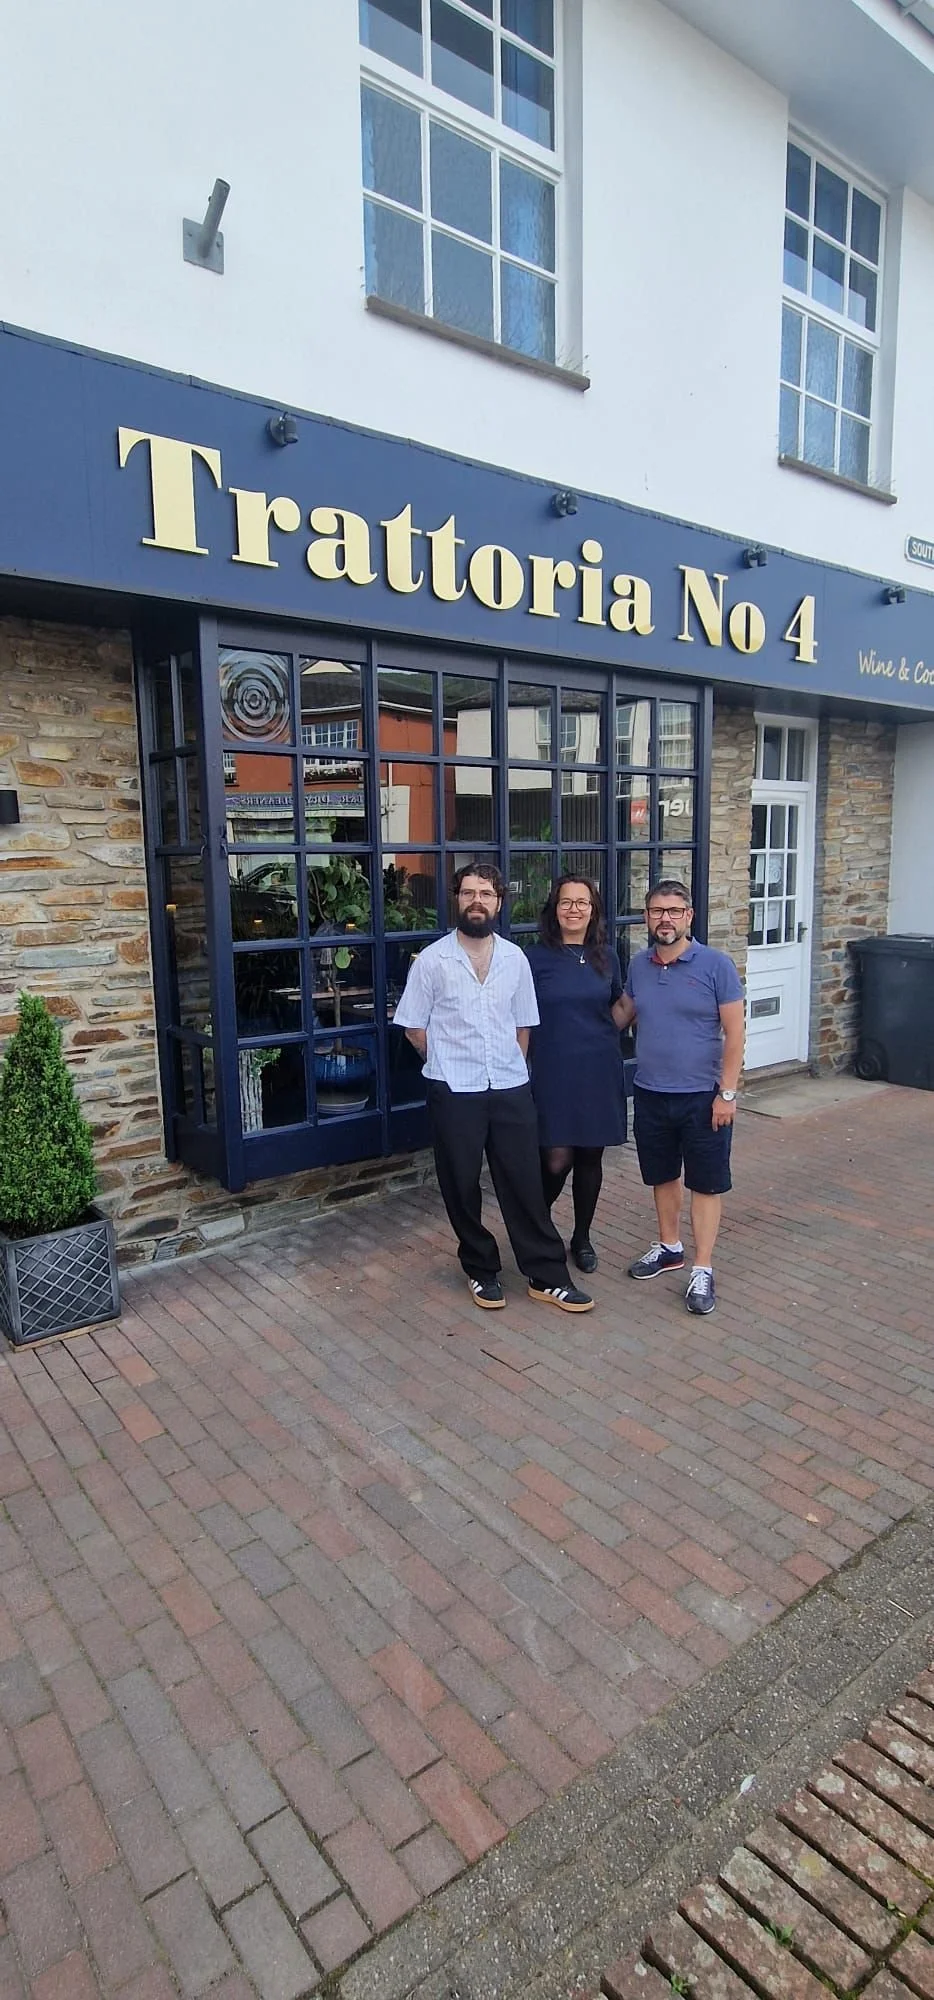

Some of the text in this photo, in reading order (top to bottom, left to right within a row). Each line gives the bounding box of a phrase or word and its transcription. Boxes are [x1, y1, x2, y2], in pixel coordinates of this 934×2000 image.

[118, 426, 818, 664] Trattoria No 4
[912, 541, 934, 560] SOUT
[859, 649, 896, 677] Wine
[899, 656, 910, 681] &
